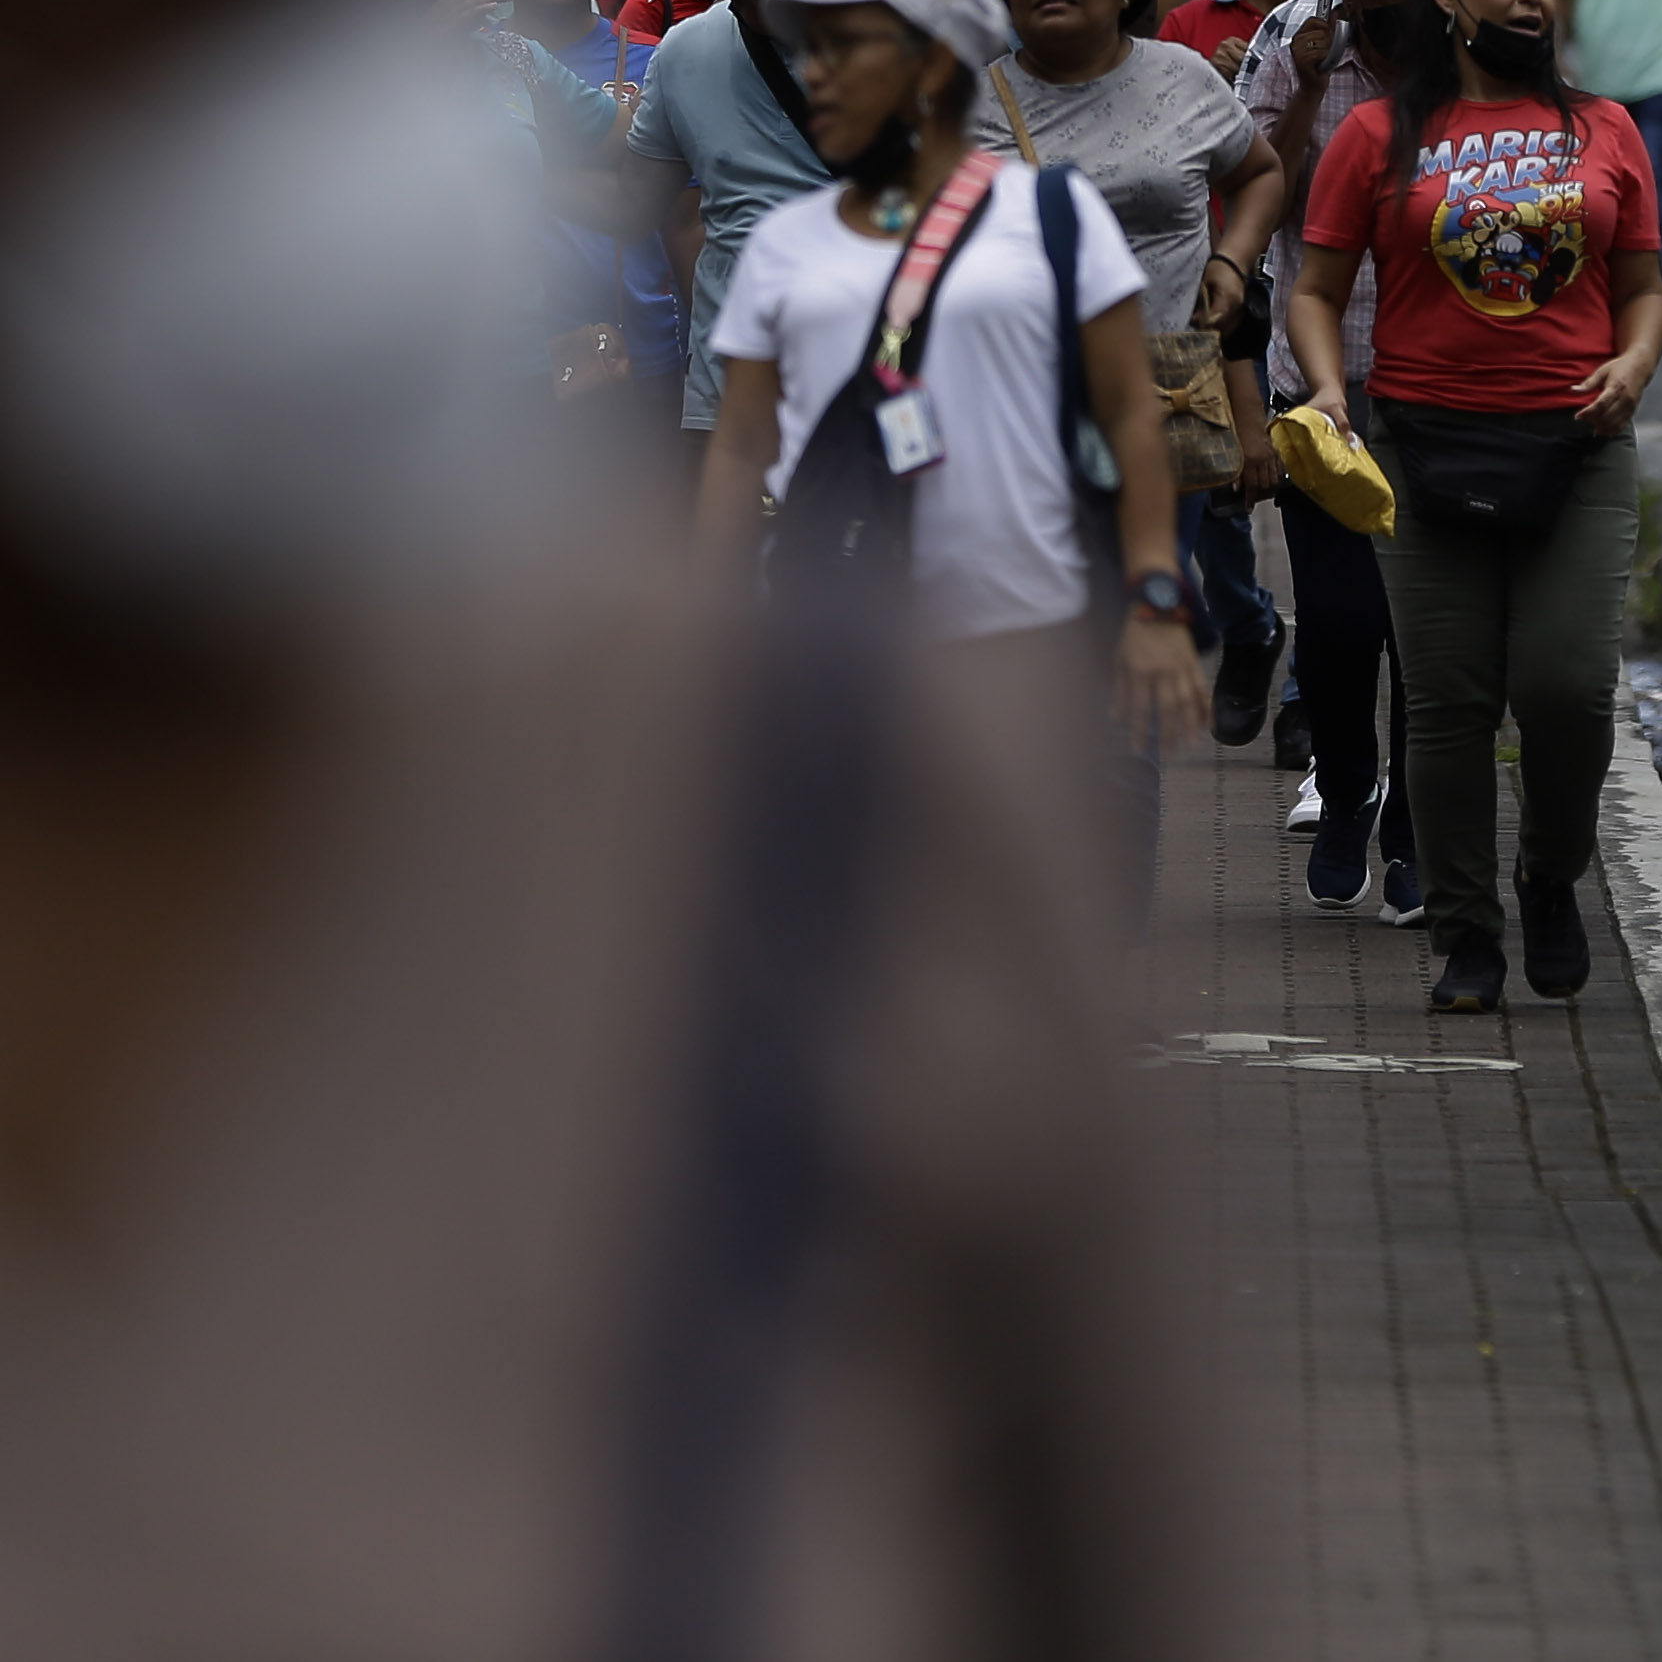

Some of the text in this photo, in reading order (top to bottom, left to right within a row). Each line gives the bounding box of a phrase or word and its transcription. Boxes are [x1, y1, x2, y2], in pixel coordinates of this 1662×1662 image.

[1411, 130, 1580, 182] MARIO
[1446, 156, 1579, 203] KART
[1539, 182, 1584, 196] SINCE
